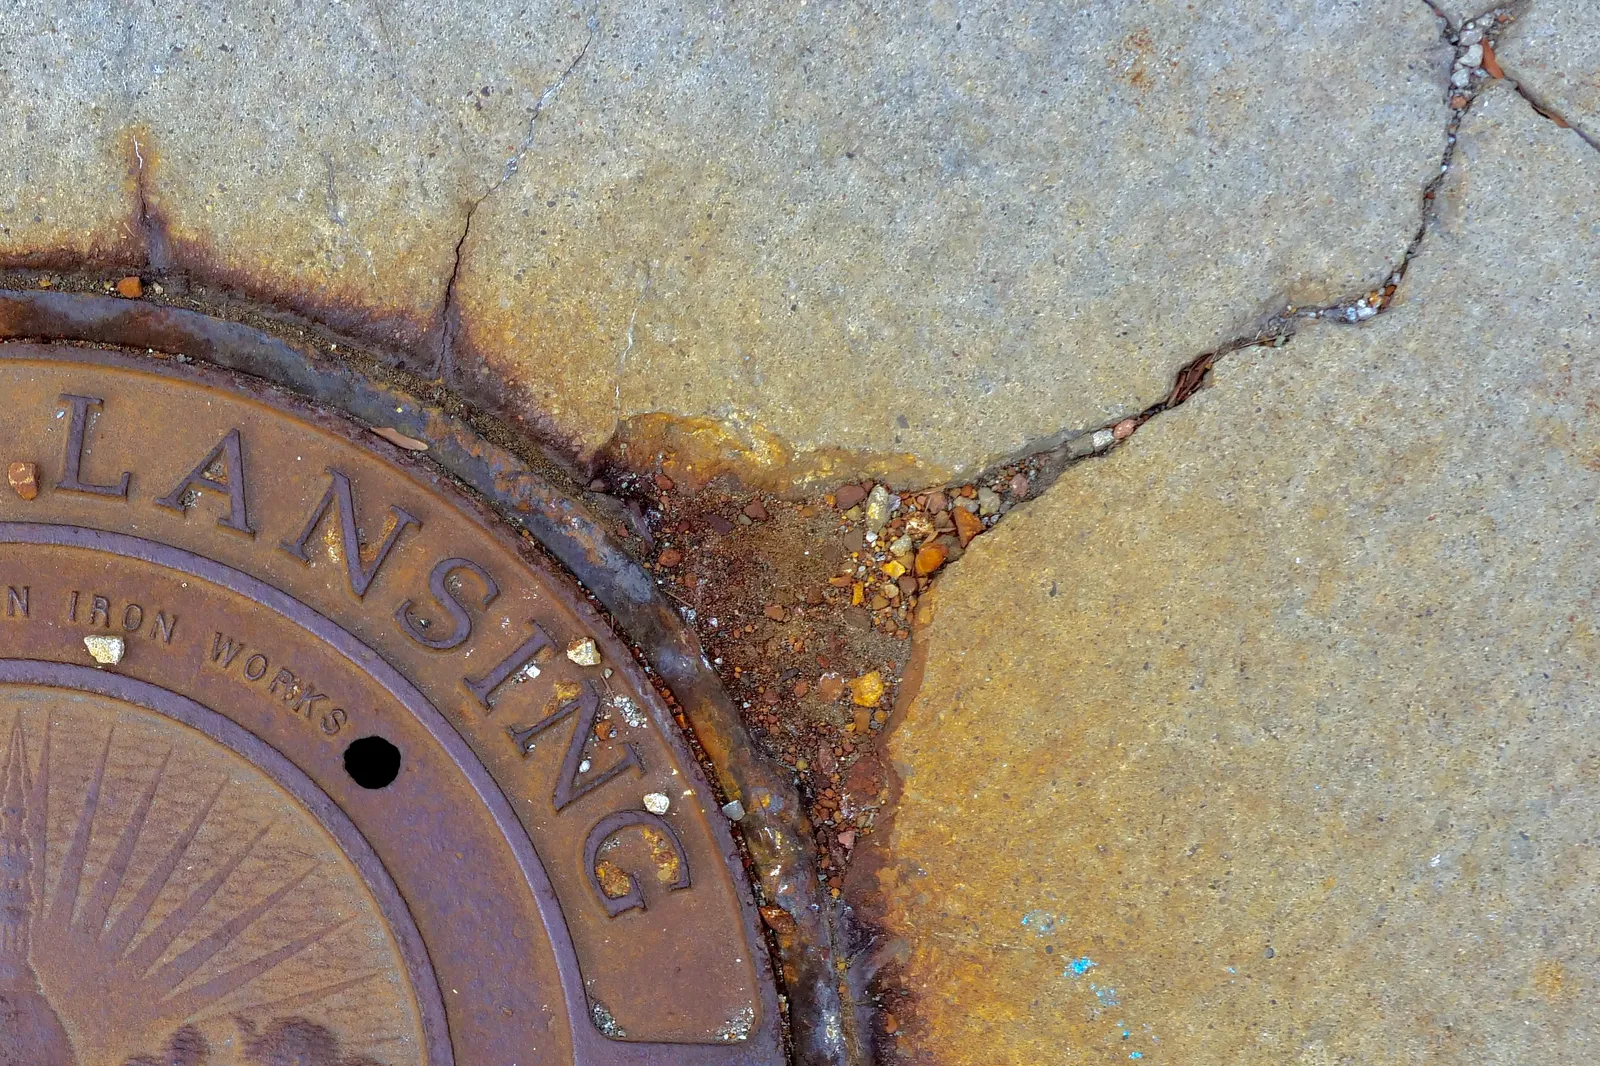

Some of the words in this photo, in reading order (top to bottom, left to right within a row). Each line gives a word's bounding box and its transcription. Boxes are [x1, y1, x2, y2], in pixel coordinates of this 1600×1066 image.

[55, 394, 692, 918] LANSING
[69, 591, 180, 644] IRON
[210, 632, 349, 736] WORKS
